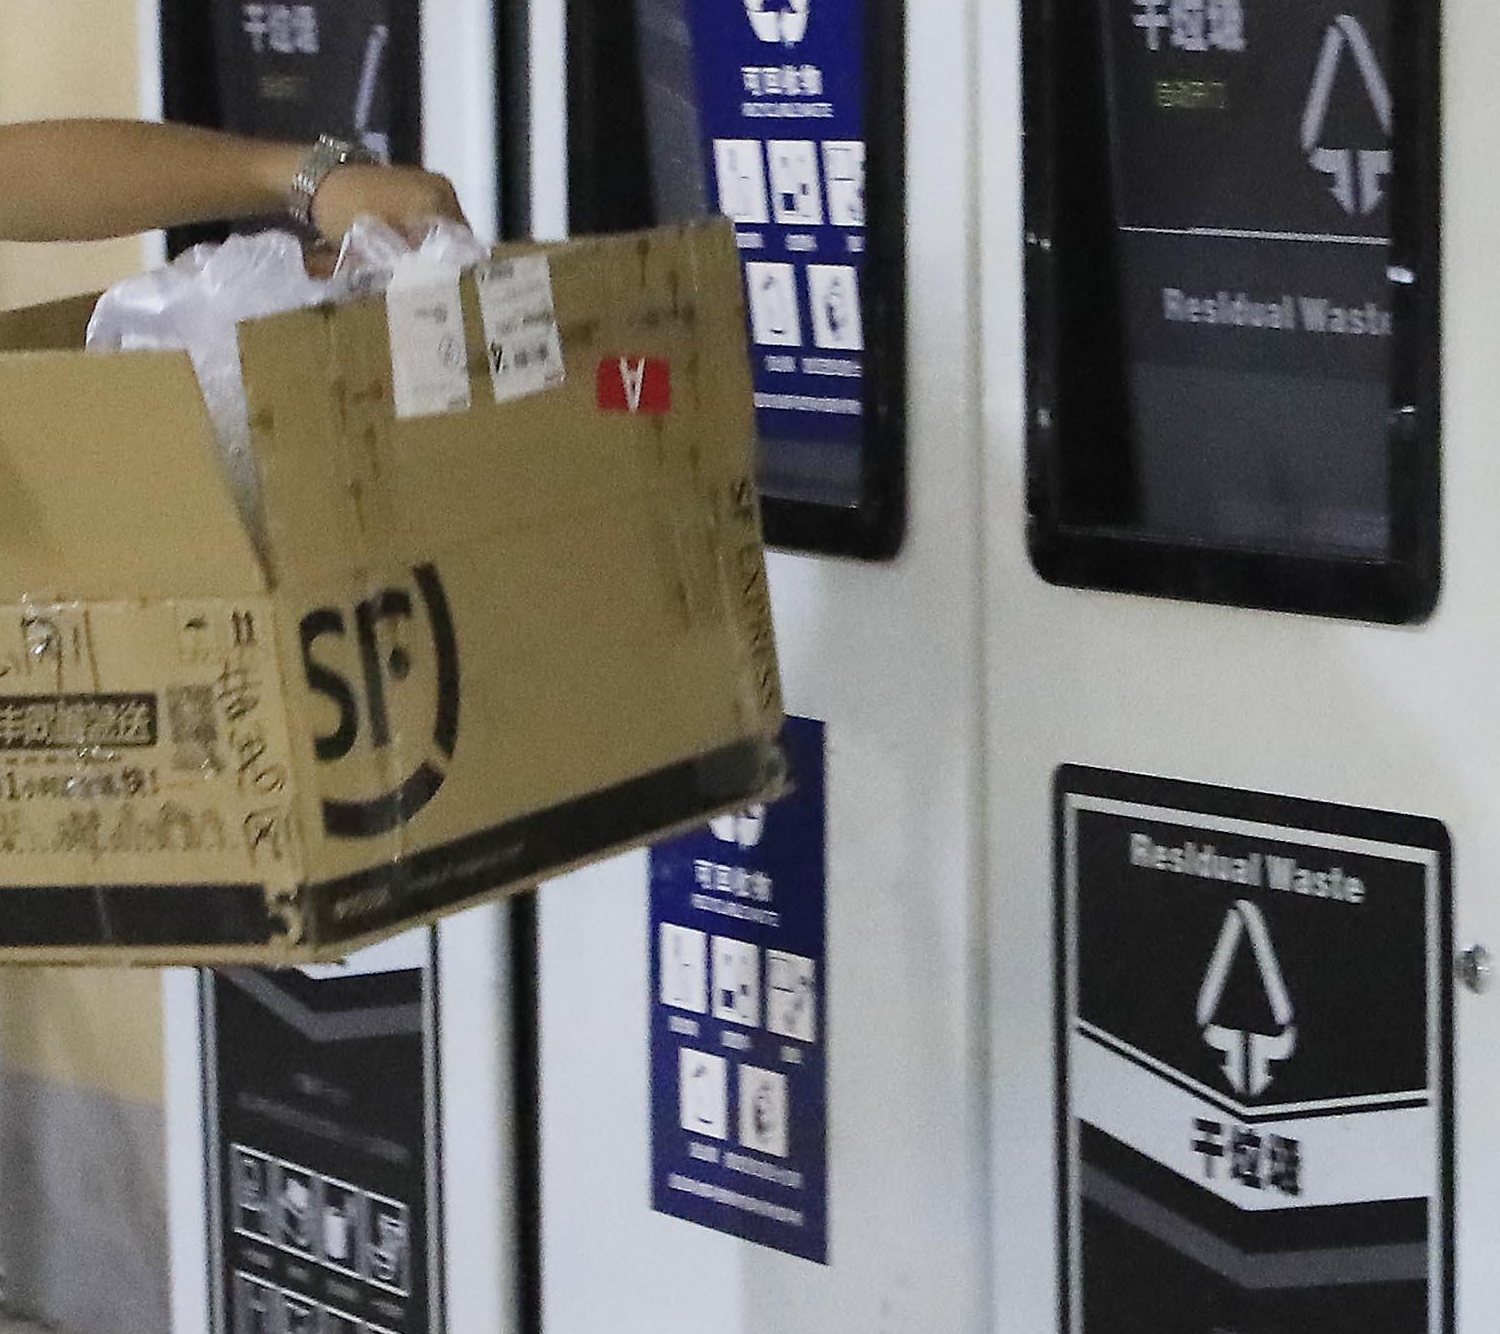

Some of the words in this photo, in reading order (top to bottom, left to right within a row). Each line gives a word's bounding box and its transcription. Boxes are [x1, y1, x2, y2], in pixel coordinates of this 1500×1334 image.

[1163, 288, 1295, 330] Residual
[299, 589, 413, 760] SF
[1131, 832, 1262, 887] Residual
[1265, 854, 1365, 903] Waste
[1191, 1116, 1301, 1196] 干垃圾
